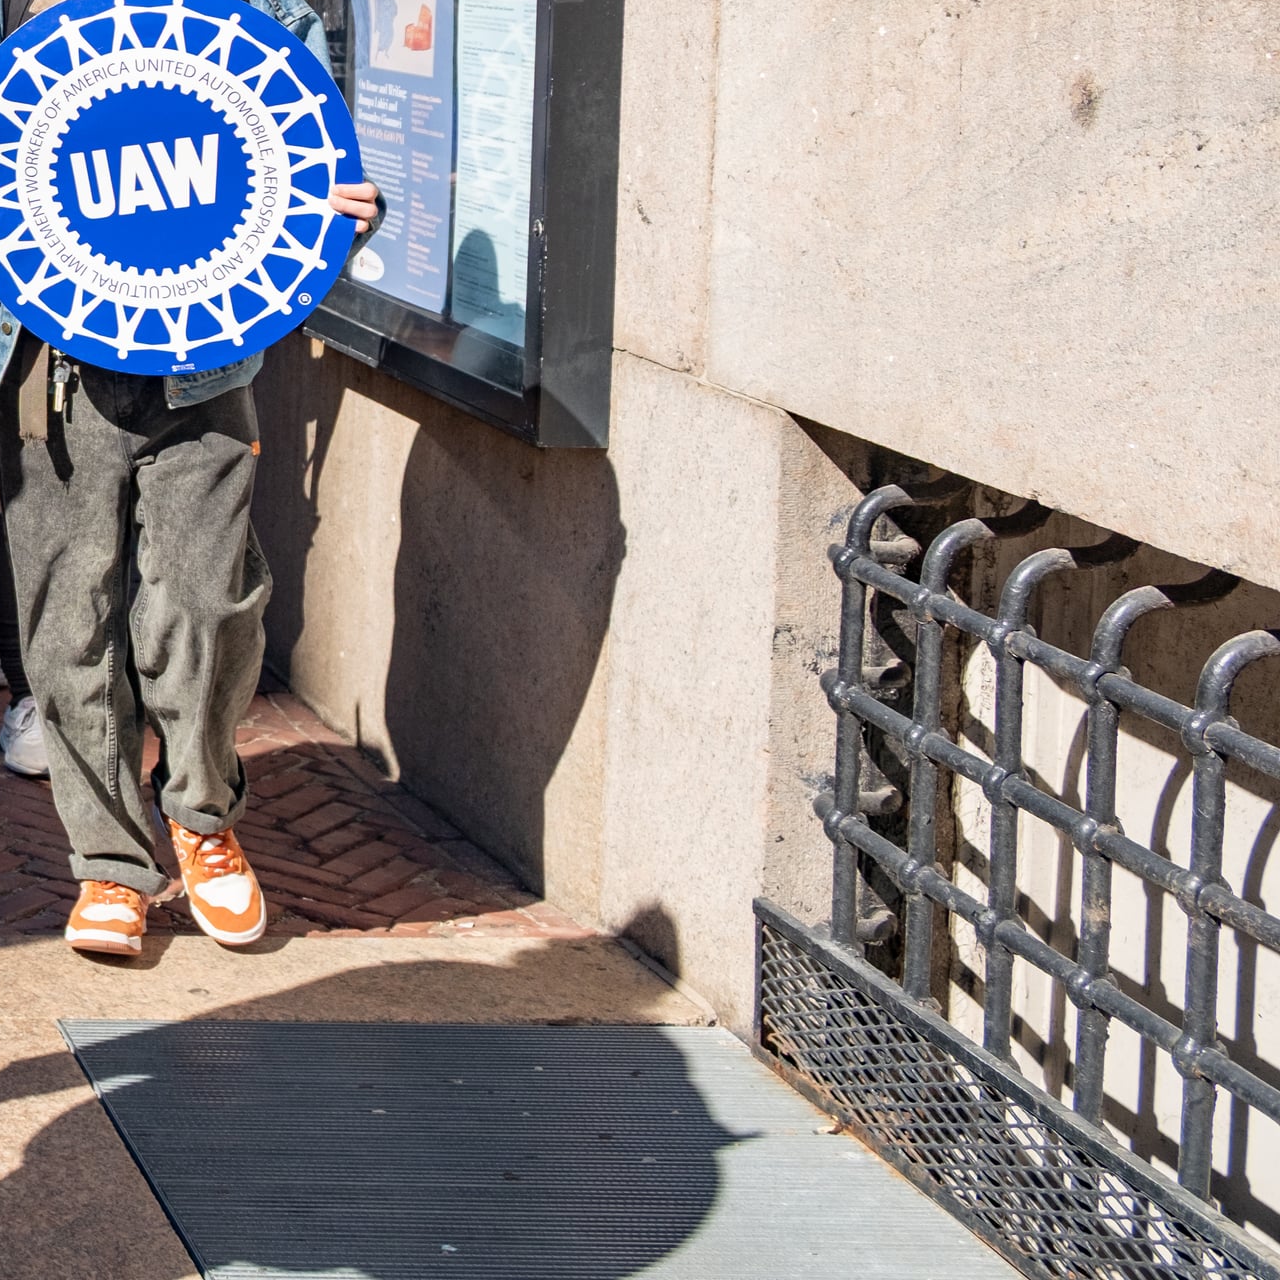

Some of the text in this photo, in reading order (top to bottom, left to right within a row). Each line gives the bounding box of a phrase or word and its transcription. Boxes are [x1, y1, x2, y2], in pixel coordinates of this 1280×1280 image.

[24, 58, 278, 299] UNITED AUTOMOBILE, AEROSPACE AND AGRICULTURAL IMPLEMENT WORKERS OF AMERICA
[70, 133, 219, 220] UAW
